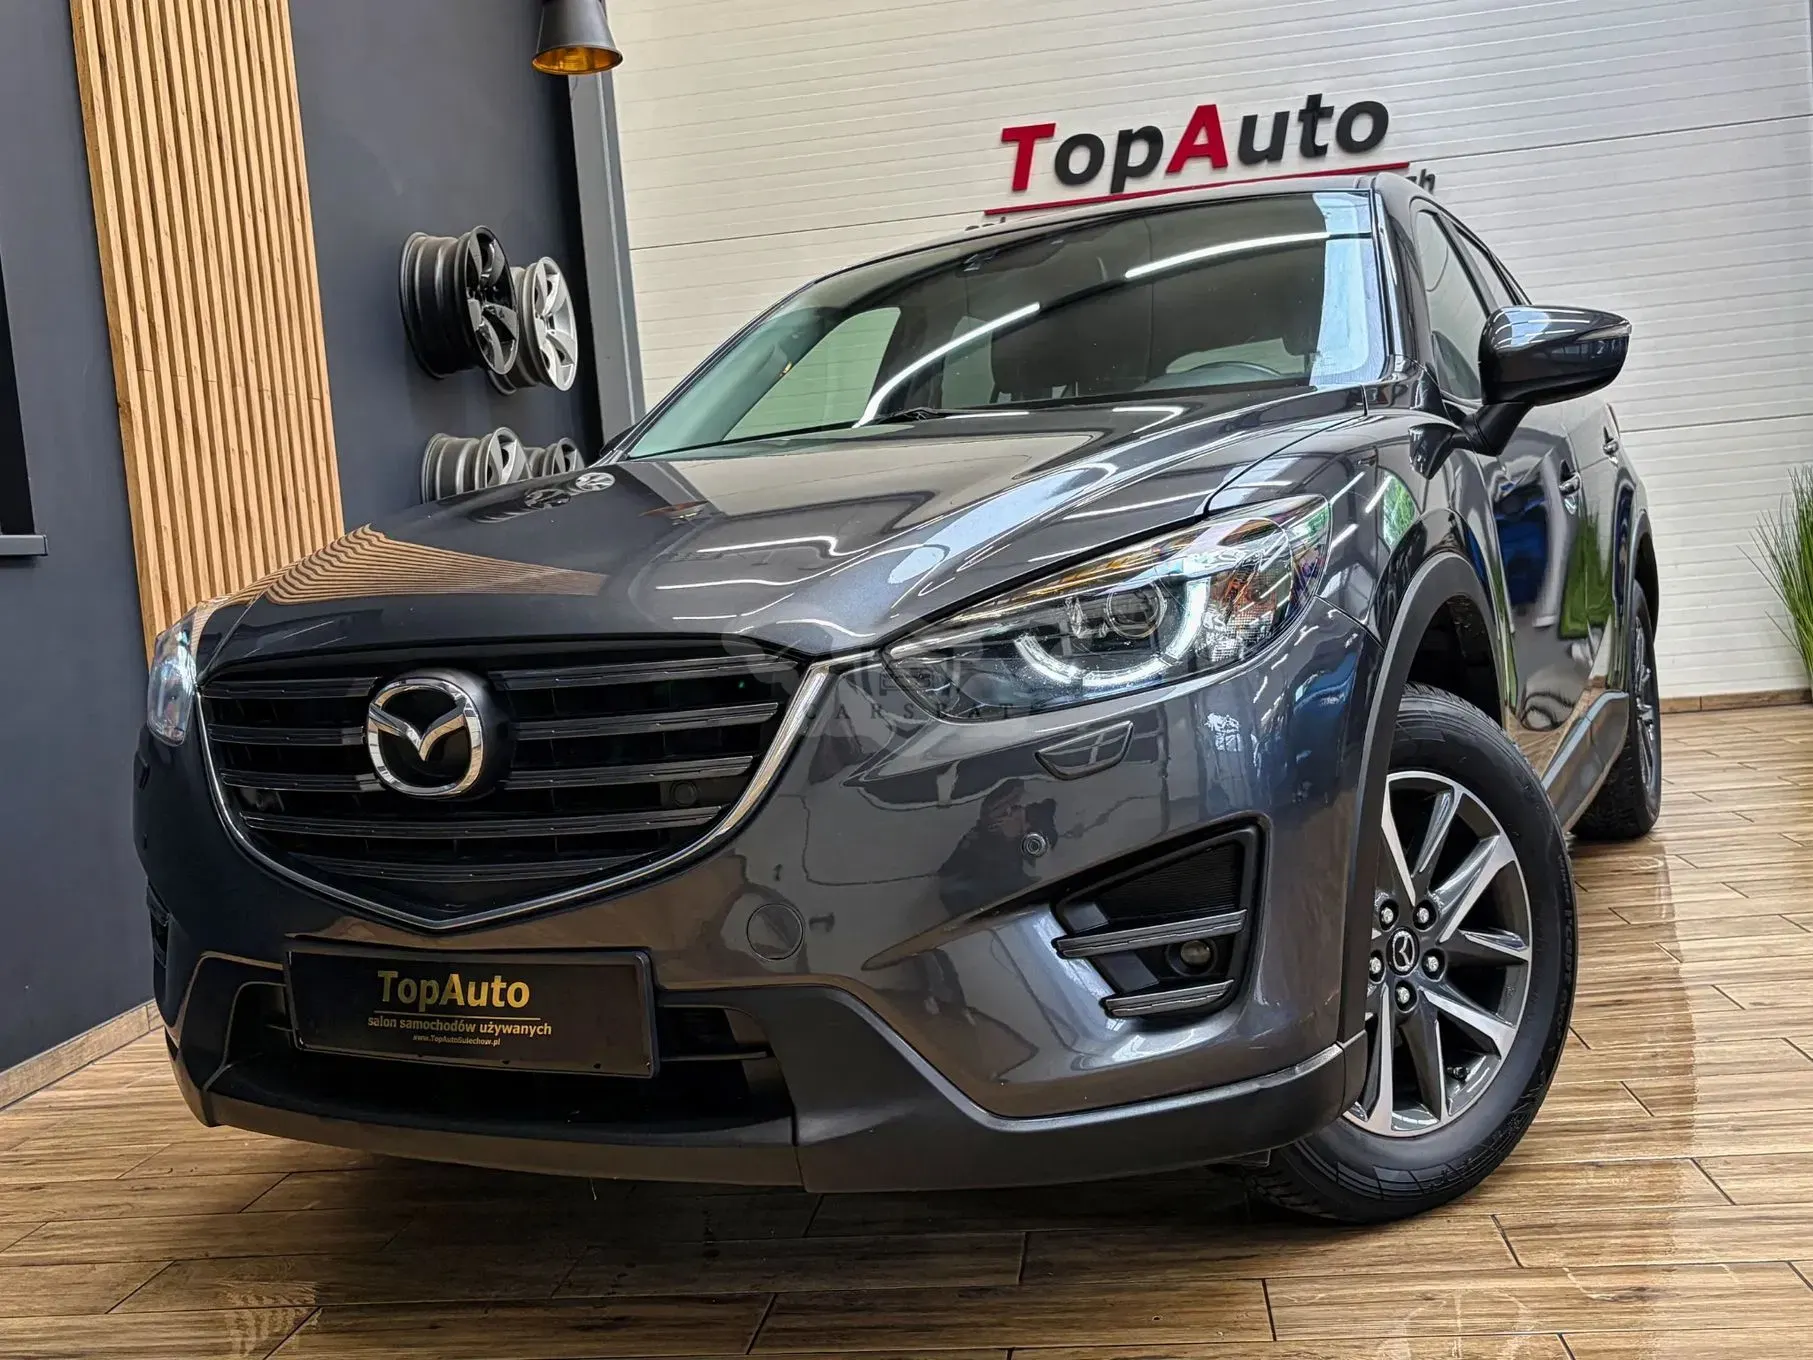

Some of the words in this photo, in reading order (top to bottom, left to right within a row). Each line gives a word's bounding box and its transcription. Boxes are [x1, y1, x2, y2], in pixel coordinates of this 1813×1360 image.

[1001, 92, 1390, 193] TopAuto
[377, 970, 530, 1012] TopAuto
[367, 1016, 397, 1028] salon
[399, 1019, 476, 1033] samochodów
[479, 1021, 552, 1037] używanych
